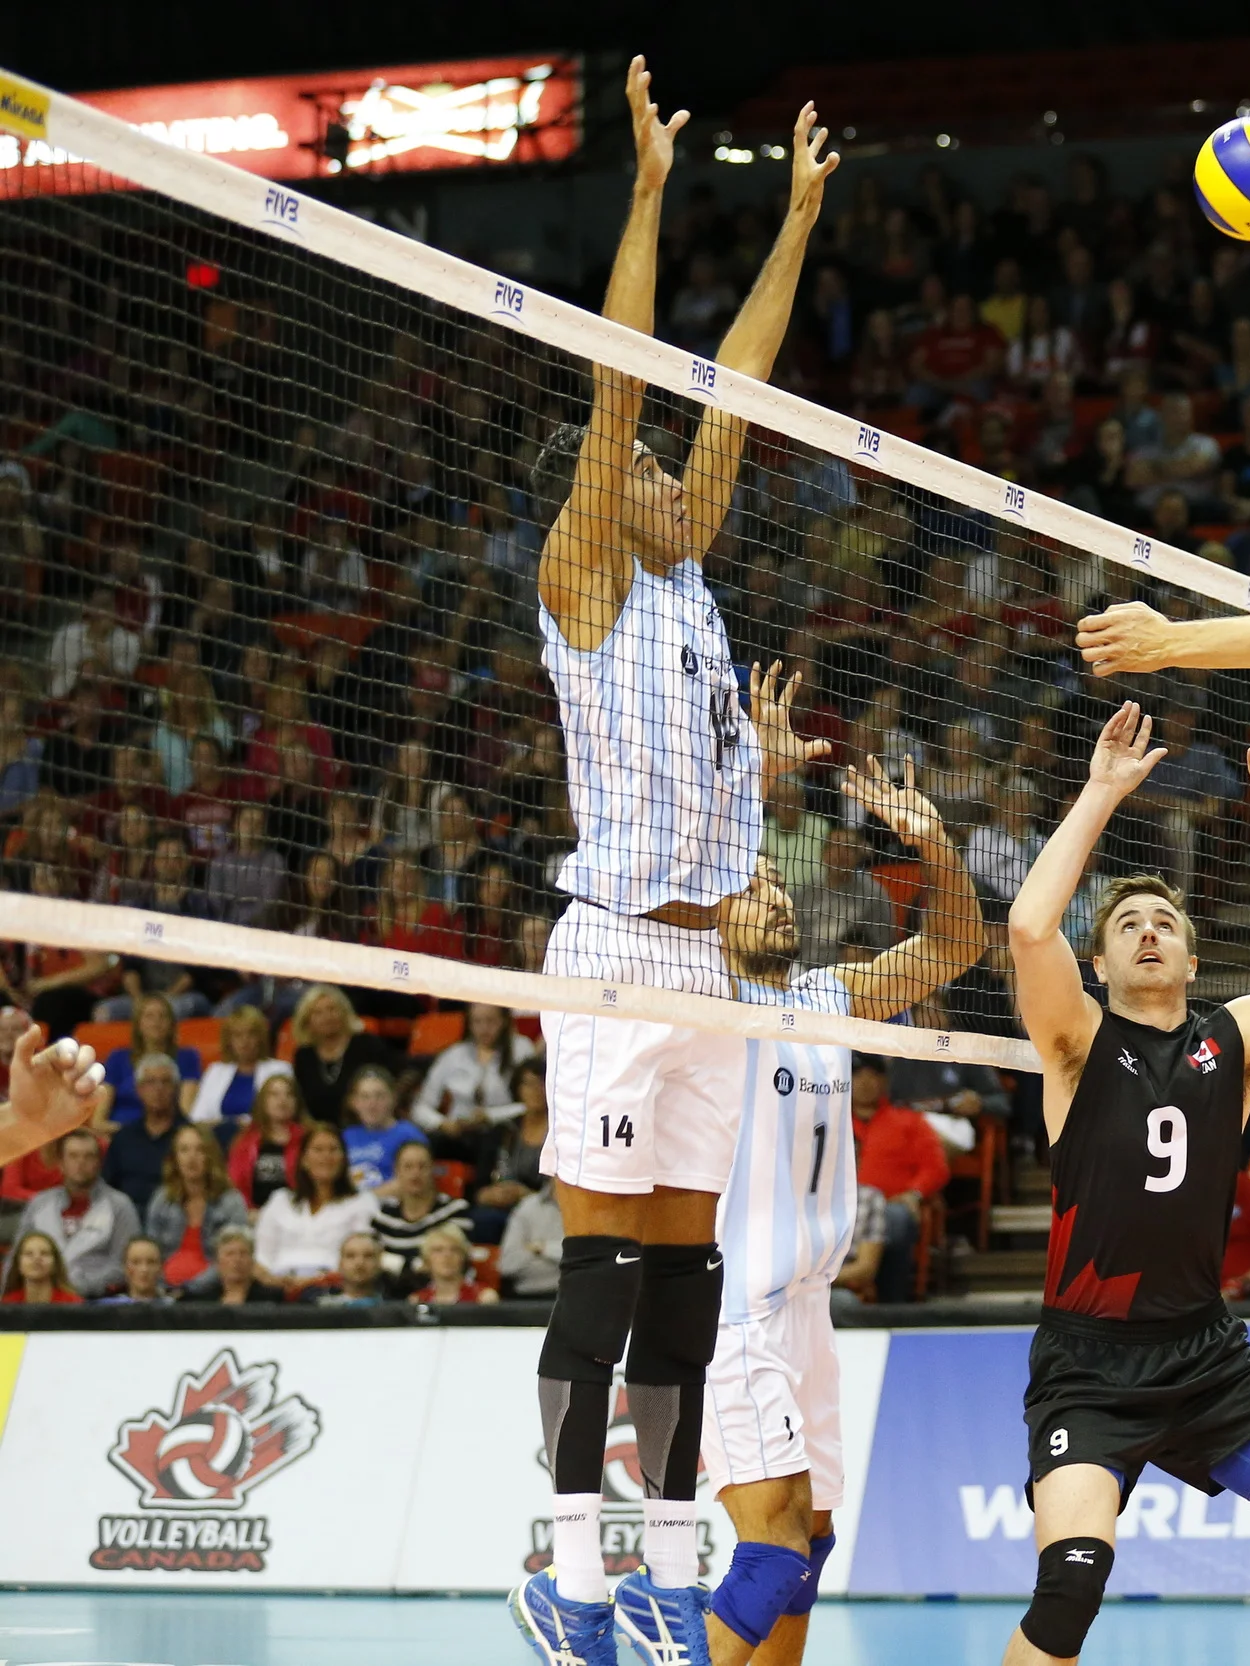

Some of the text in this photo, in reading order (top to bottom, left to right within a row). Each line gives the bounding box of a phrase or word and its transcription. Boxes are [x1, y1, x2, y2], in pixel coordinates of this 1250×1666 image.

[265, 188, 299, 222] FIVB
[494, 281, 524, 312] FIVB
[691, 360, 716, 388] FIVB
[857, 426, 881, 452] FIVB
[1005, 486, 1025, 509] FIVB
[1133, 538, 1151, 559] FIVB
[393, 960, 409, 976] FIVB
[602, 989, 617, 1002] FIVB
[781, 1013, 795, 1027] FIVB
[936, 1035, 950, 1048] FIVB
[799, 1078, 830, 1095] Banco
[600, 1114, 635, 1147] 14
[810, 1122, 826, 1193] 1
[1144, 1105, 1188, 1193] 9
[1050, 1427, 1069, 1457] 9
[102, 1518, 269, 1549] VOLLEYBALL
[92, 1549, 264, 1571] CANADA
